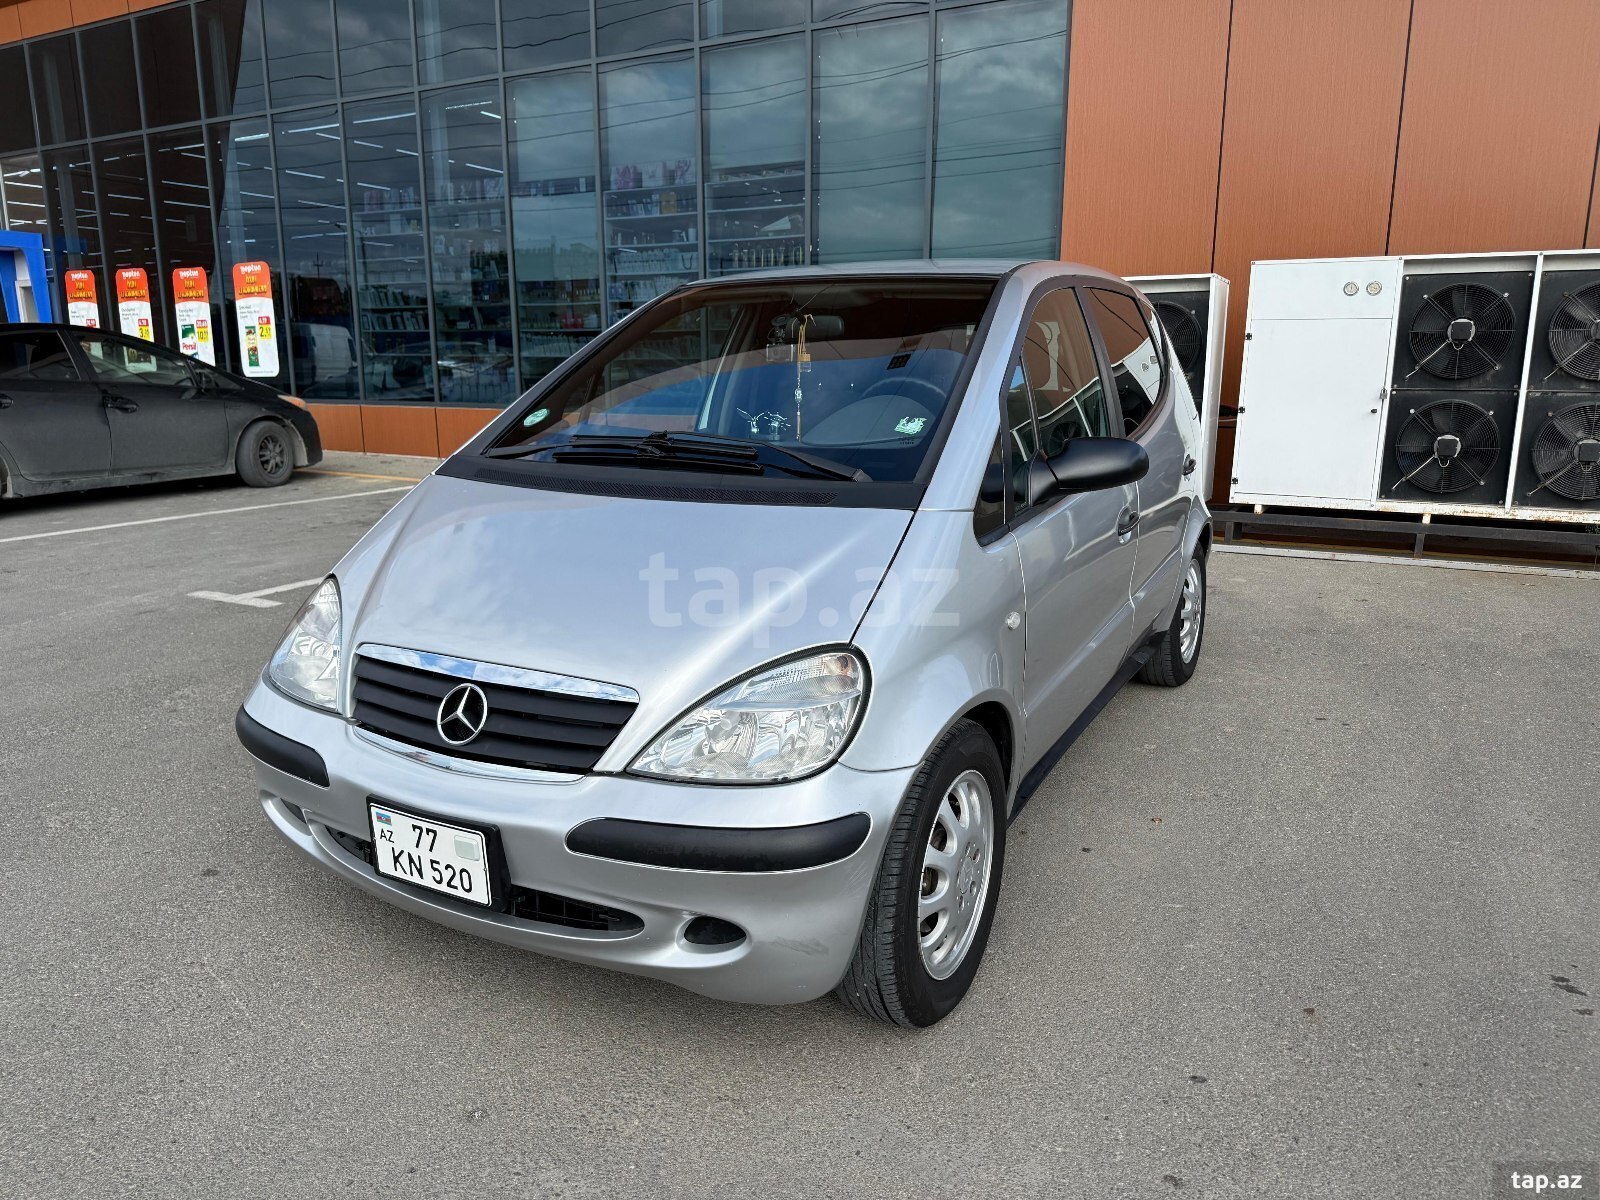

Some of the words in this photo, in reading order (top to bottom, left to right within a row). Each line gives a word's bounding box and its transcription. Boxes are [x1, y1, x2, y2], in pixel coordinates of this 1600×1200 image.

[182, 341, 197, 351] Persil
[379, 828, 395, 843] AZ
[412, 823, 438, 852] 77
[391, 846, 424, 880] KN
[429, 858, 473, 893] 520
